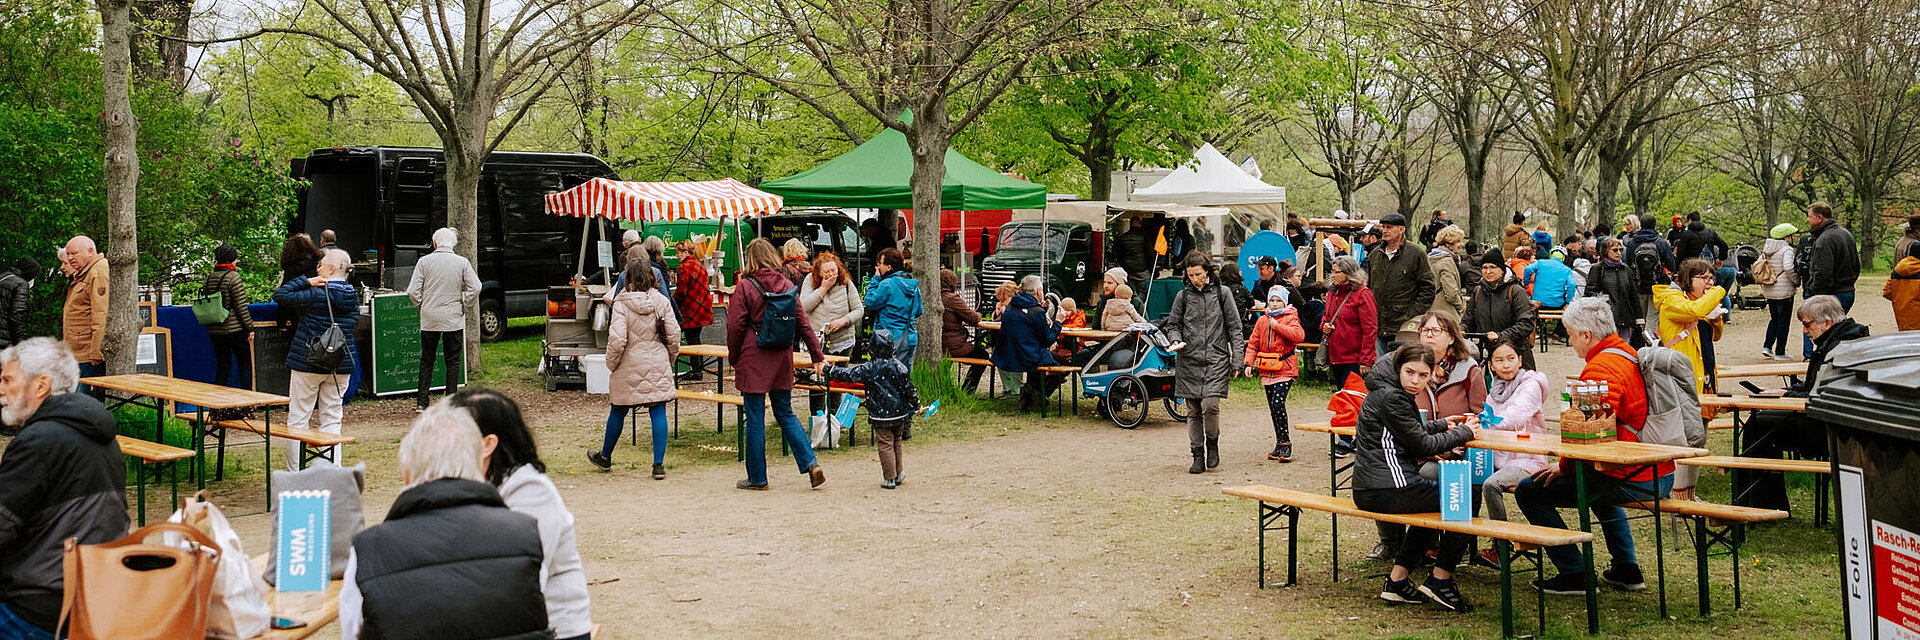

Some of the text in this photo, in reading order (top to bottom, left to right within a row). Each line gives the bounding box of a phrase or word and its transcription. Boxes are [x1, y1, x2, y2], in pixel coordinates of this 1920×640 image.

[1475, 450, 1484, 477] SWM
[1449, 482, 1460, 512] SWM
[289, 527, 307, 577] SWM
[1848, 537, 1862, 600] Folie
